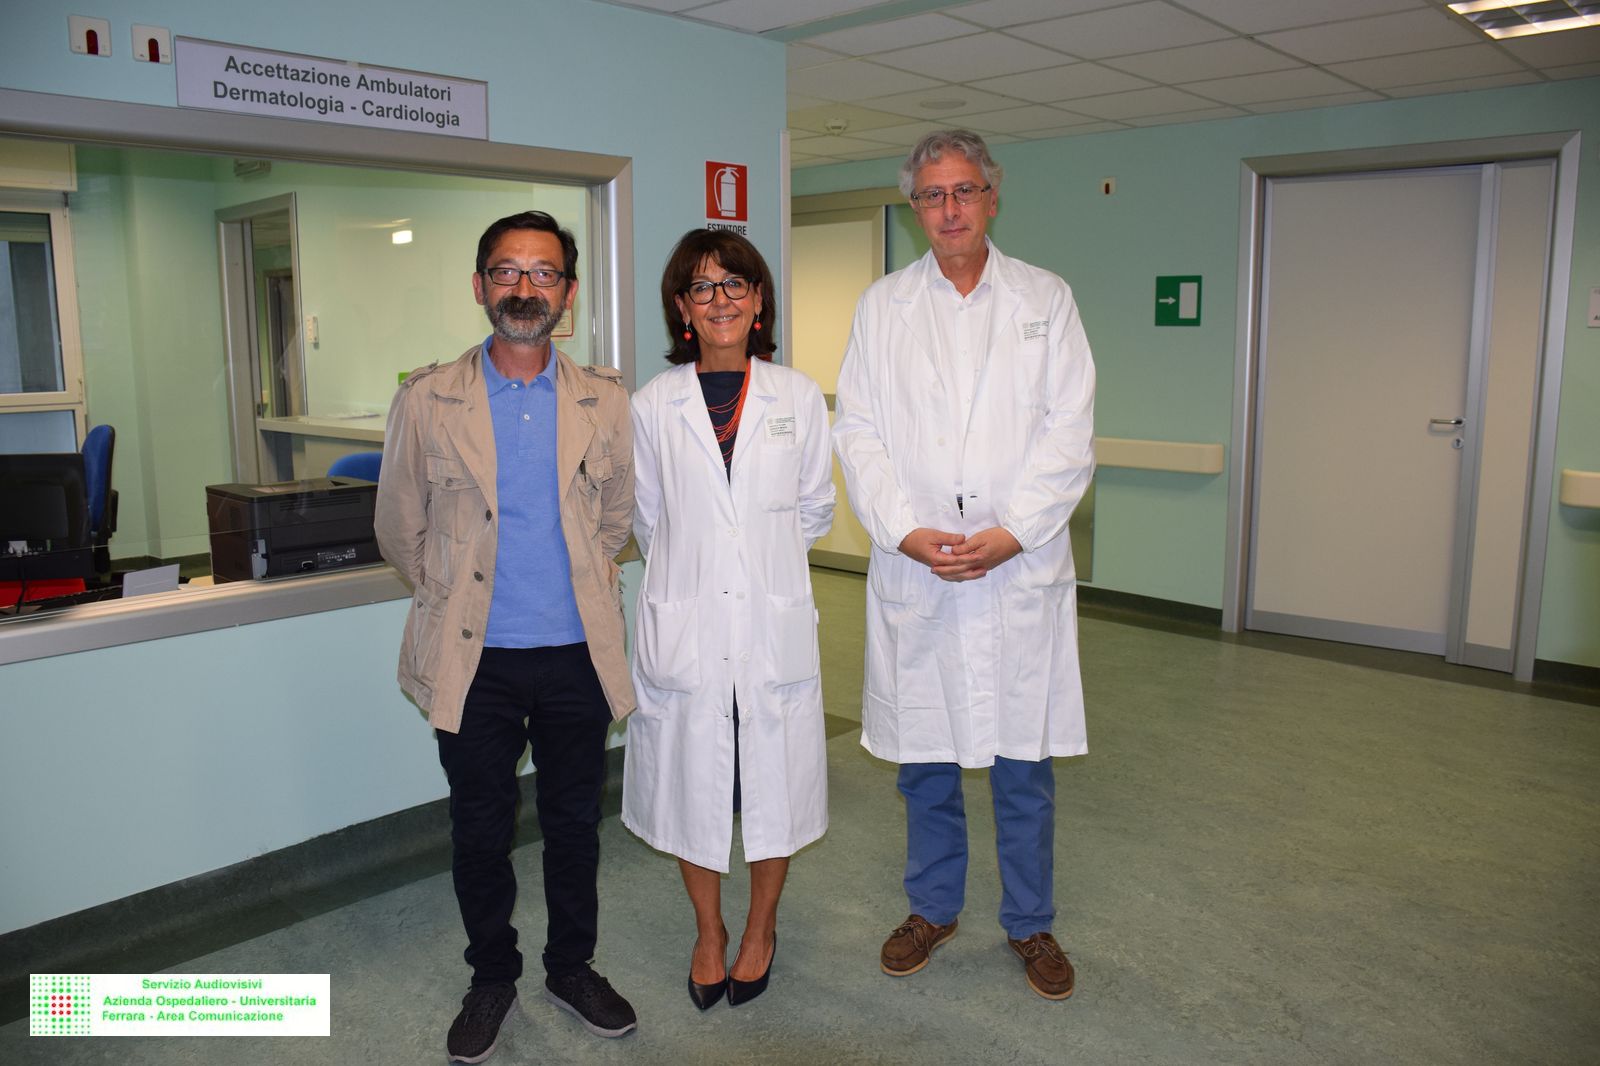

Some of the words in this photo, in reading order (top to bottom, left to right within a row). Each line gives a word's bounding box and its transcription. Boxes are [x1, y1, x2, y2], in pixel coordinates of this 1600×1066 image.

[224, 55, 350, 88] Accettazione
[356, 74, 451, 101] Ambulatori
[213, 80, 344, 115] Dermatologia
[362, 100, 460, 128] Cardiologia
